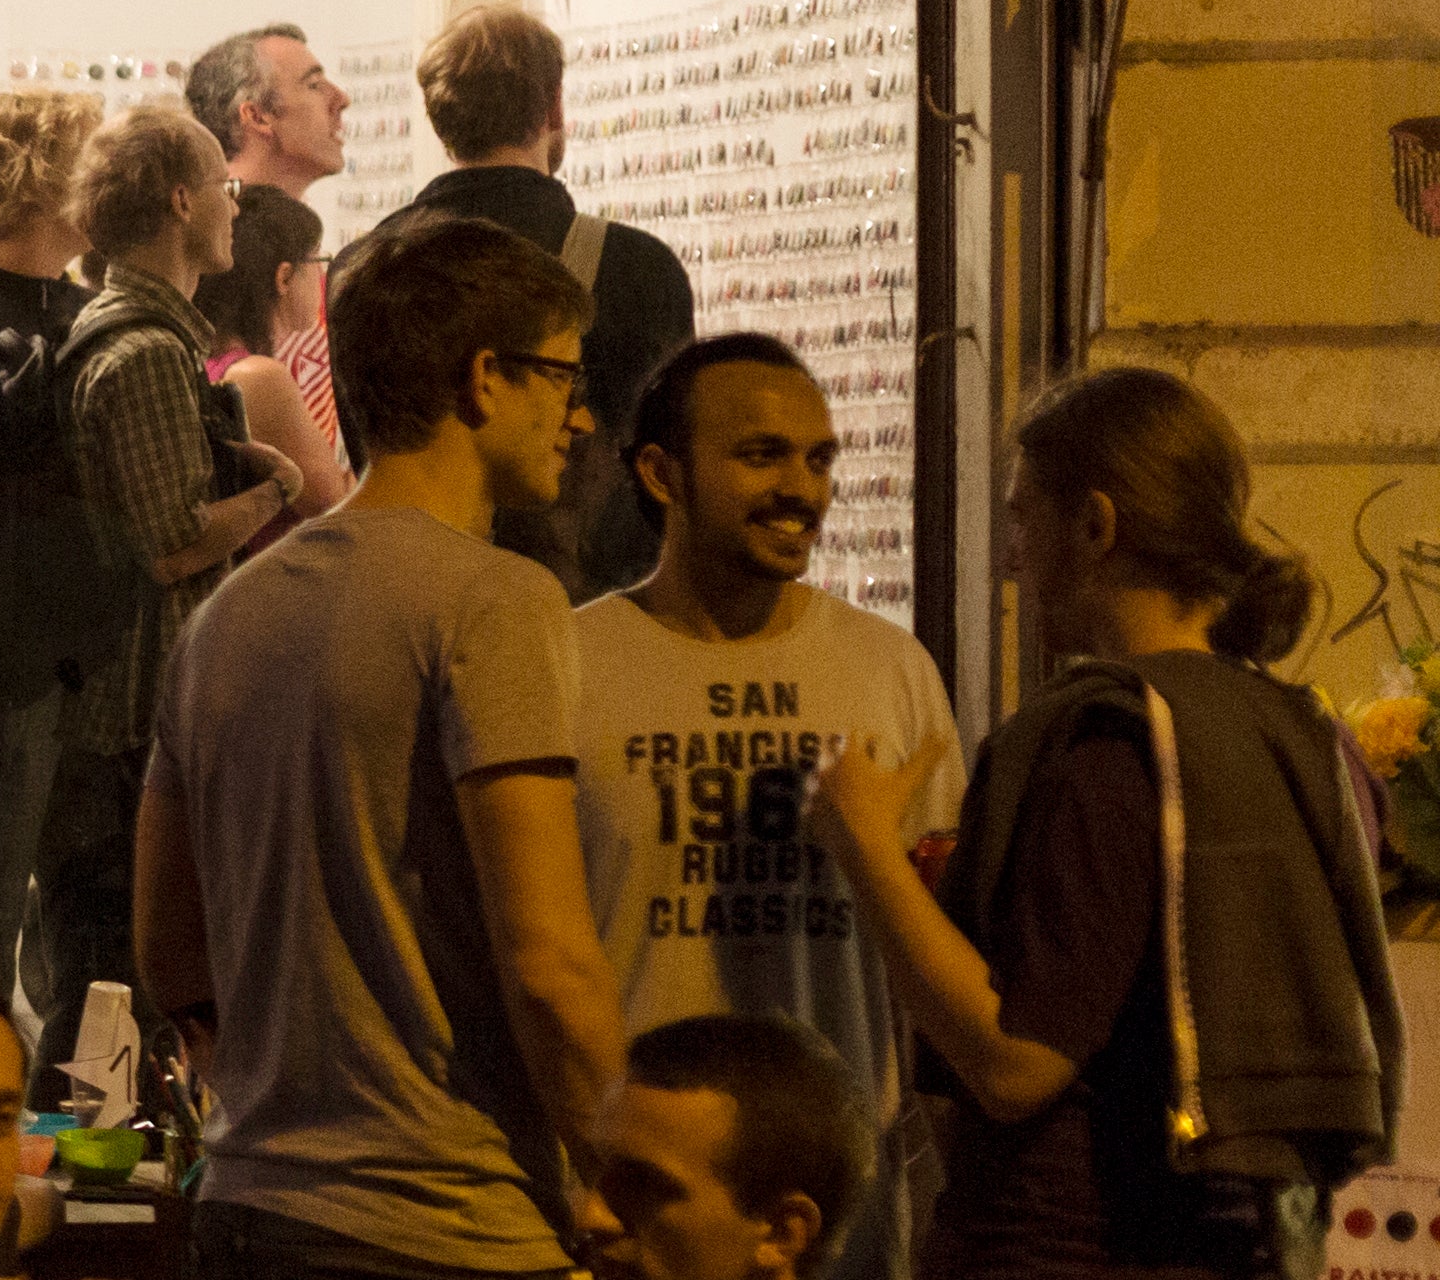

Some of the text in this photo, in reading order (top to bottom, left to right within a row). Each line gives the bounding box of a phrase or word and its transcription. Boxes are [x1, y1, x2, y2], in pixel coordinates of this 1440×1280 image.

[708, 682, 800, 718] SAN
[625, 730, 852, 772] FRANCIS
[682, 843, 826, 884] RUGBY
[648, 894, 853, 939] CLASSICS
